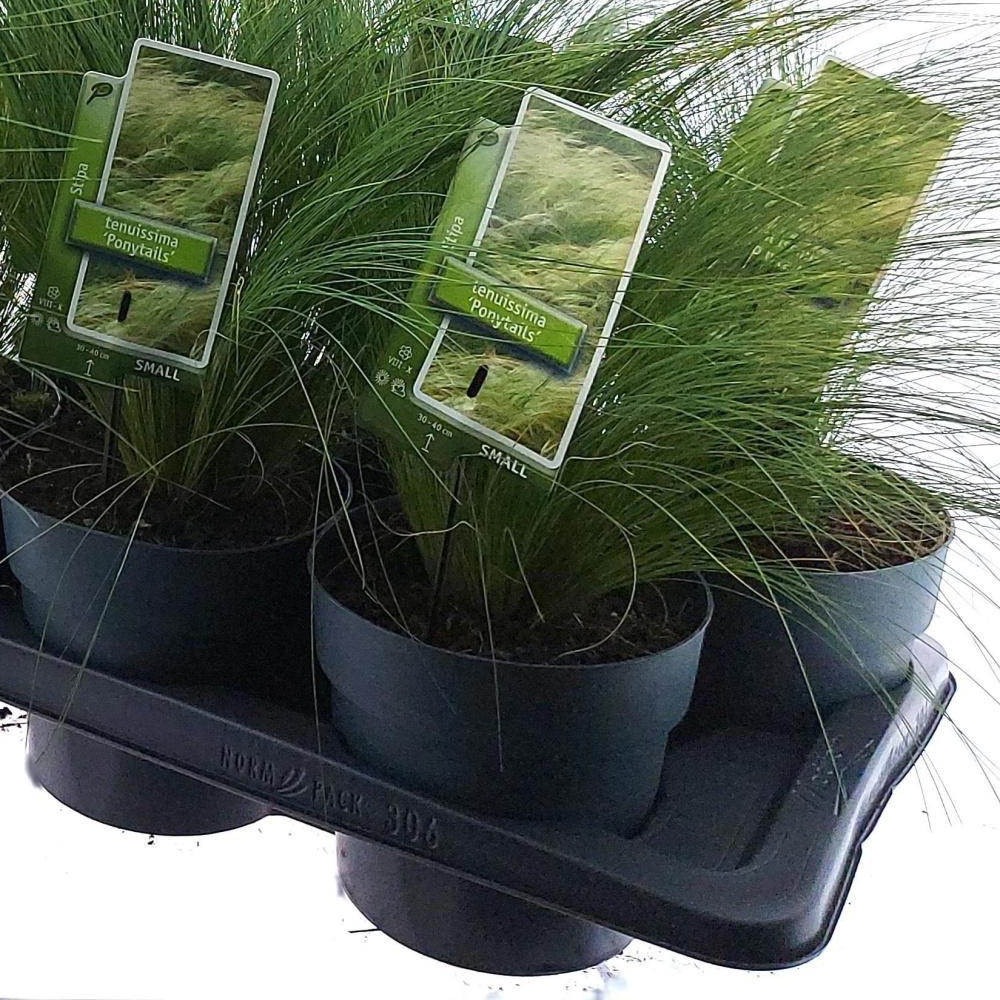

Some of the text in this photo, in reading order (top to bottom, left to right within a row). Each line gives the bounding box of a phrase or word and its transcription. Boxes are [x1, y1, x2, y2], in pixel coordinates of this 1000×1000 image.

[69, 162, 89, 196] Stipa
[105, 216, 179, 248] tenuissima
[134, 359, 180, 382] SMALL
[480, 444, 528, 479] SMALL
[219, 745, 277, 787] NORM
